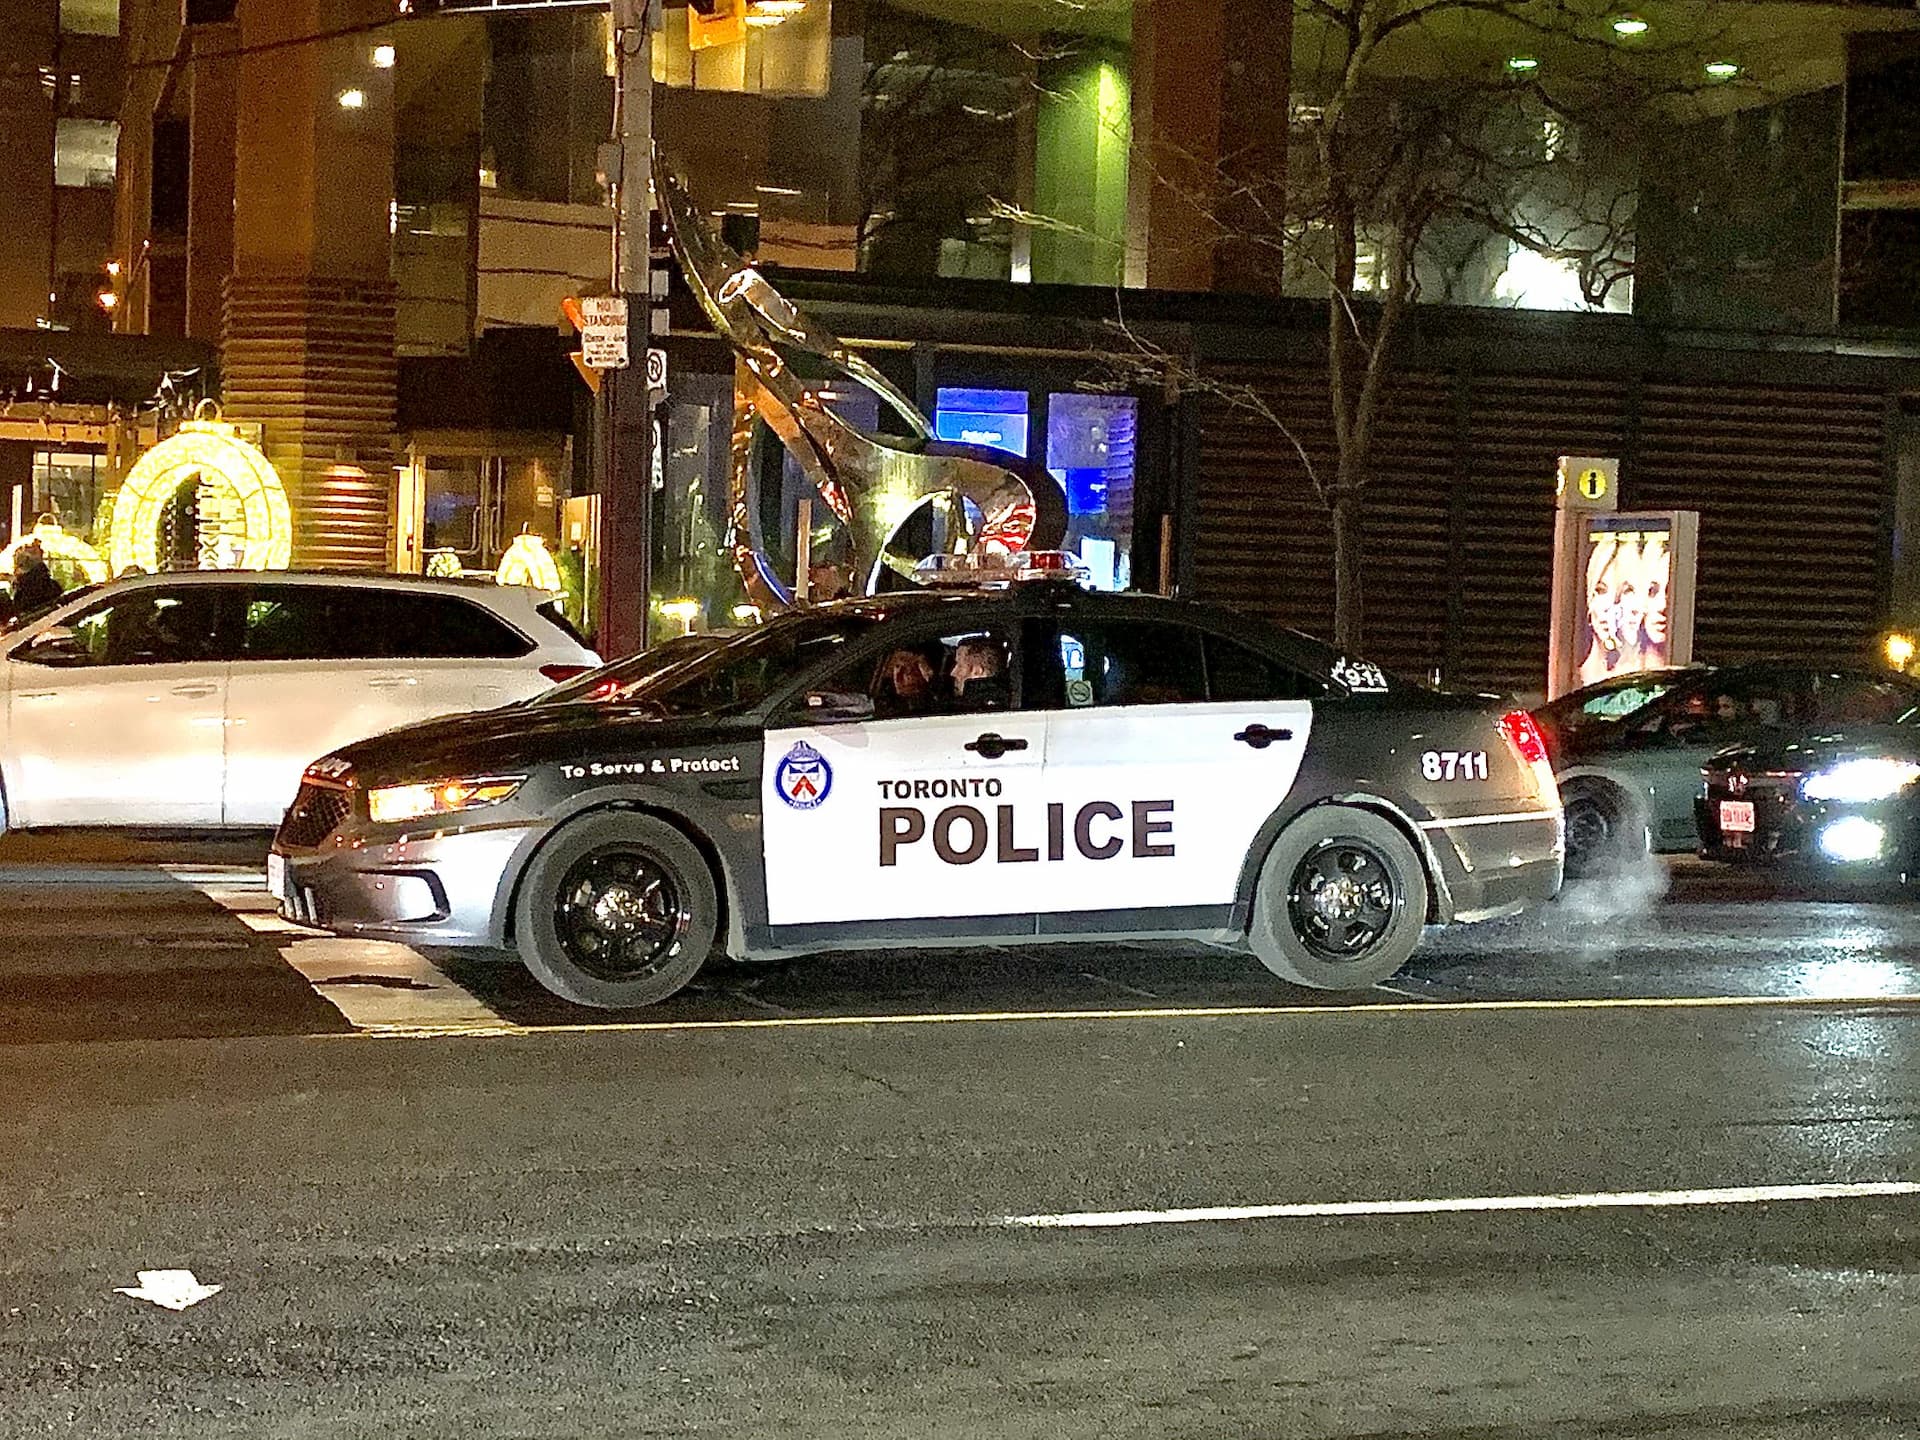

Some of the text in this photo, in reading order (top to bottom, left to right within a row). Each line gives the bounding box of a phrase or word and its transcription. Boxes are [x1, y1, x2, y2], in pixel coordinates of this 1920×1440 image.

[560, 756, 740, 779] To Serve & Protect
[1421, 750, 1488, 781] 8711
[877, 778, 1002, 799] TORONTO
[879, 799, 1176, 867] POLICE
